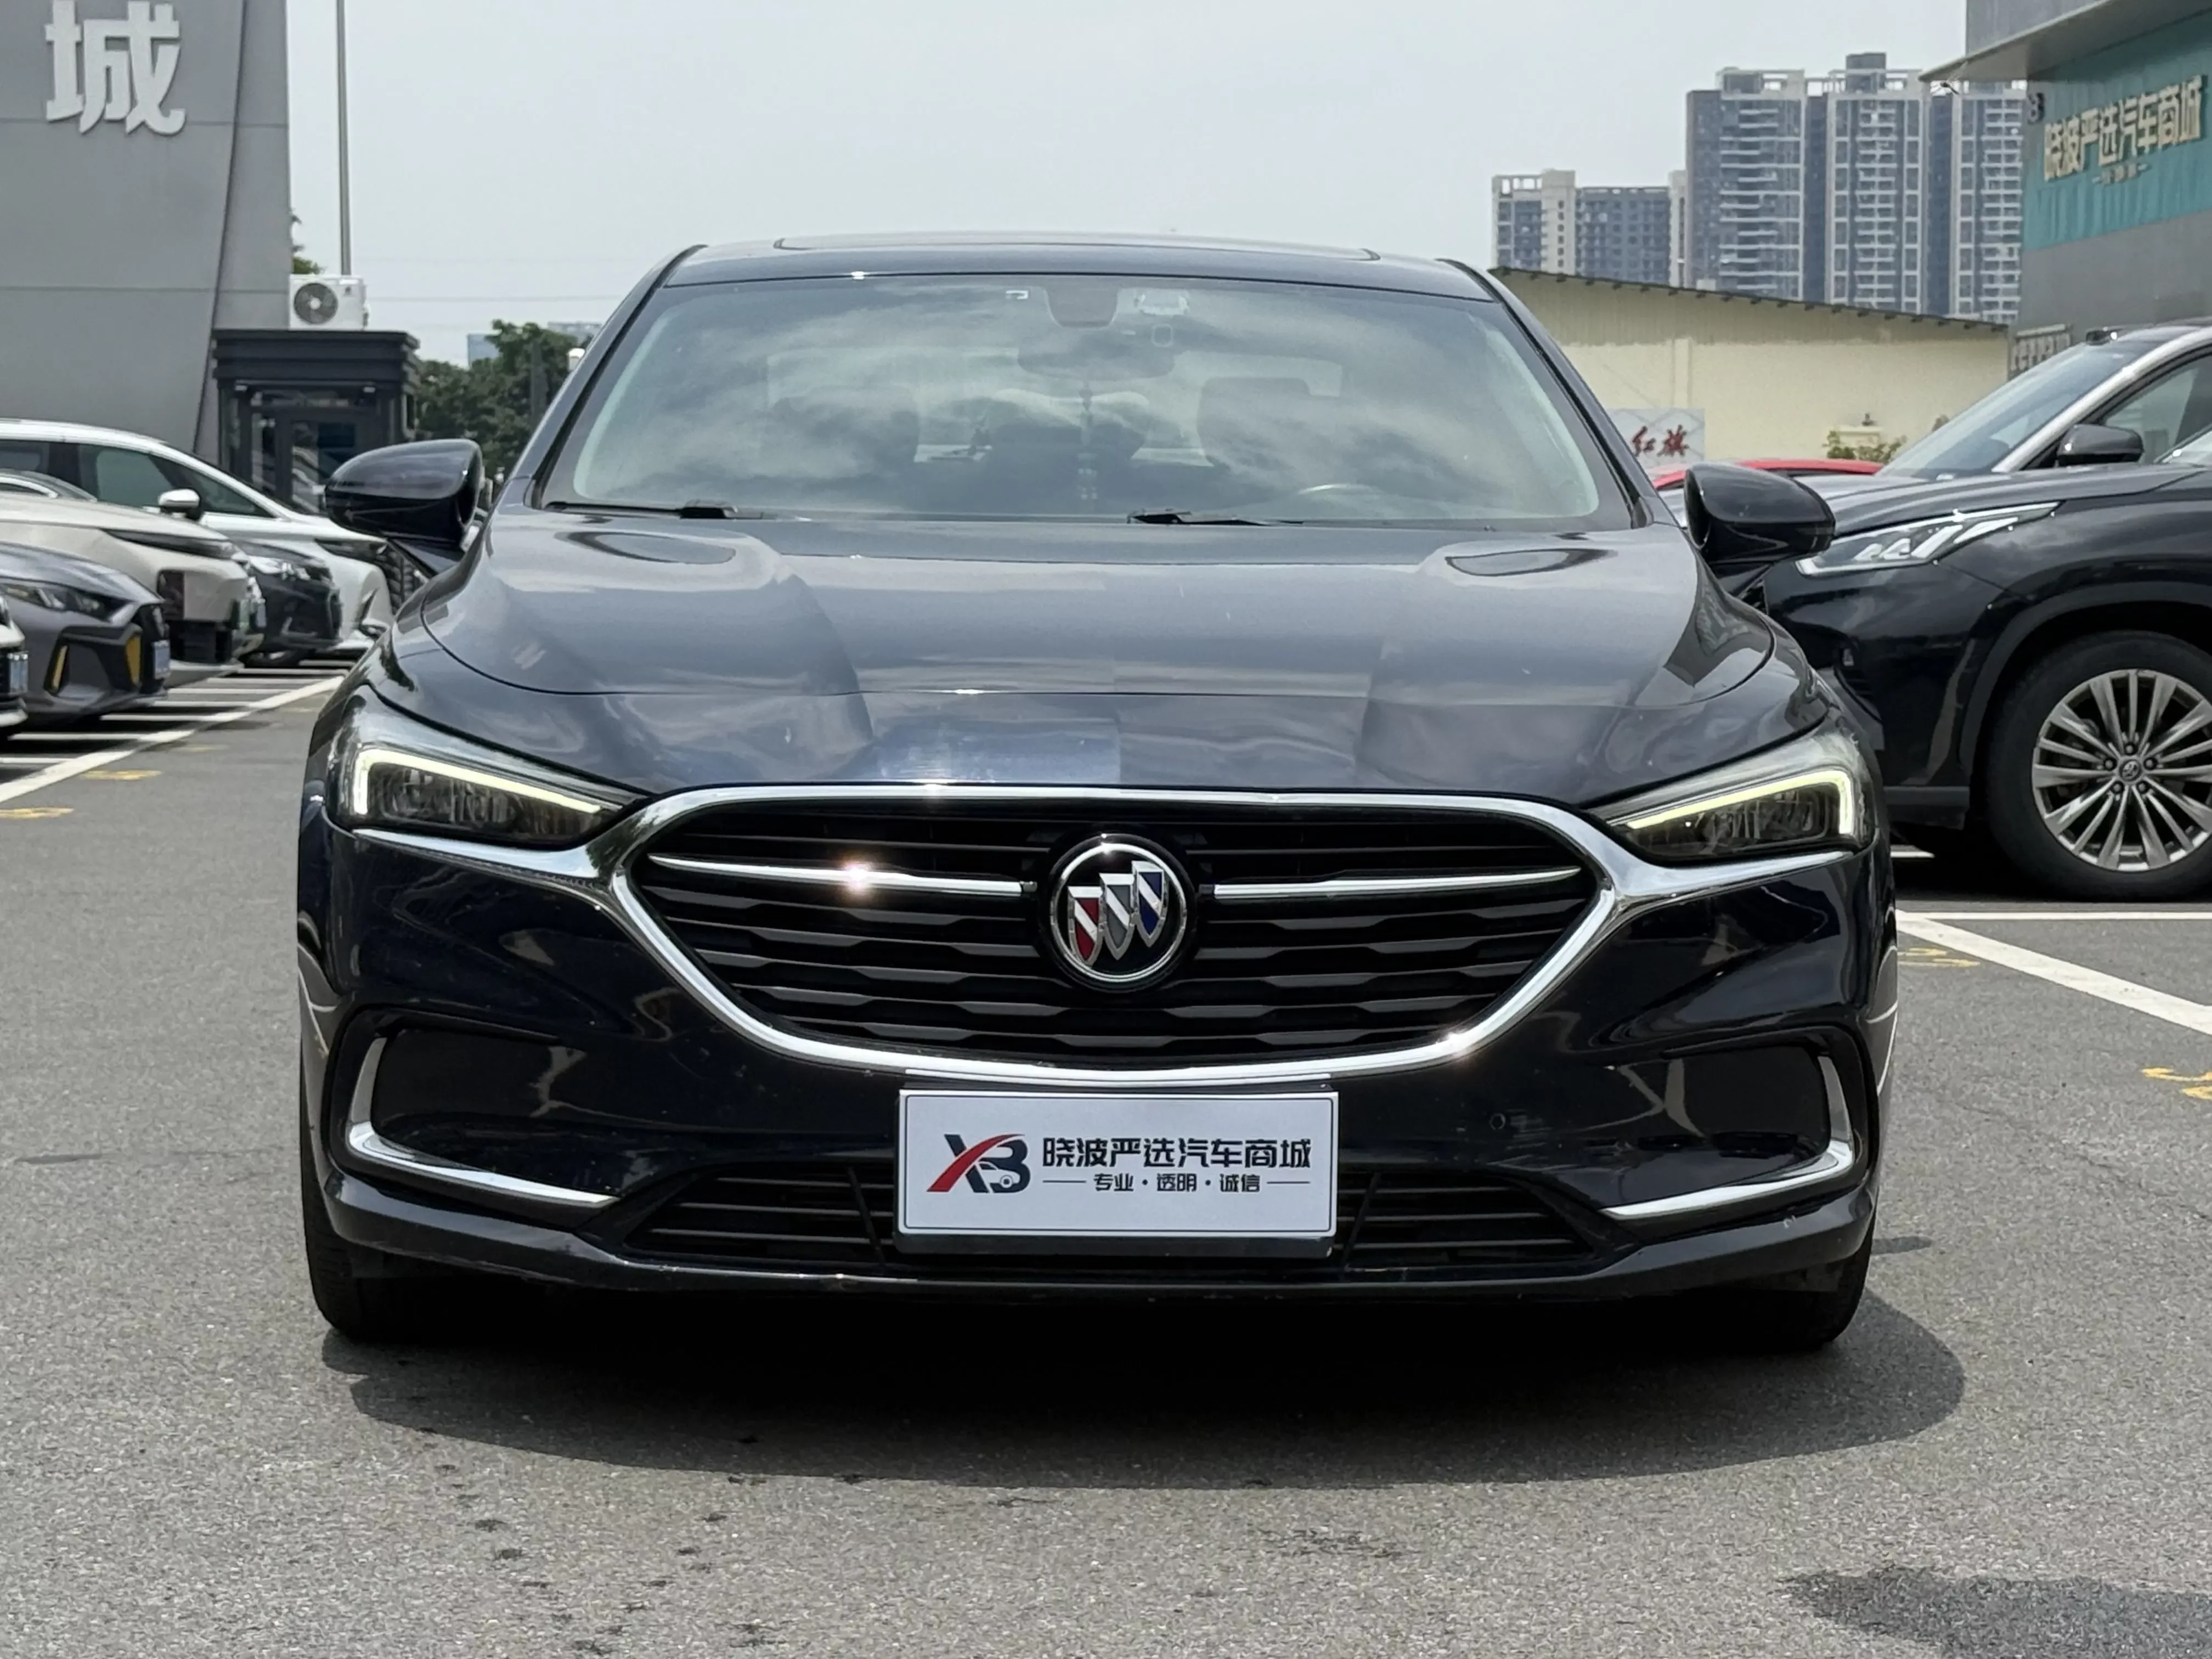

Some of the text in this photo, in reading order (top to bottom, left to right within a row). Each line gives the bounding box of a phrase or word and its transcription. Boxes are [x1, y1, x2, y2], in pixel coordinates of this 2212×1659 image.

[43, 0, 187, 136] 城
[2044, 75, 2202, 182] 晓波严选汽车商城
[1042, 1137, 1311, 1168] 晓波严选汽车商城
